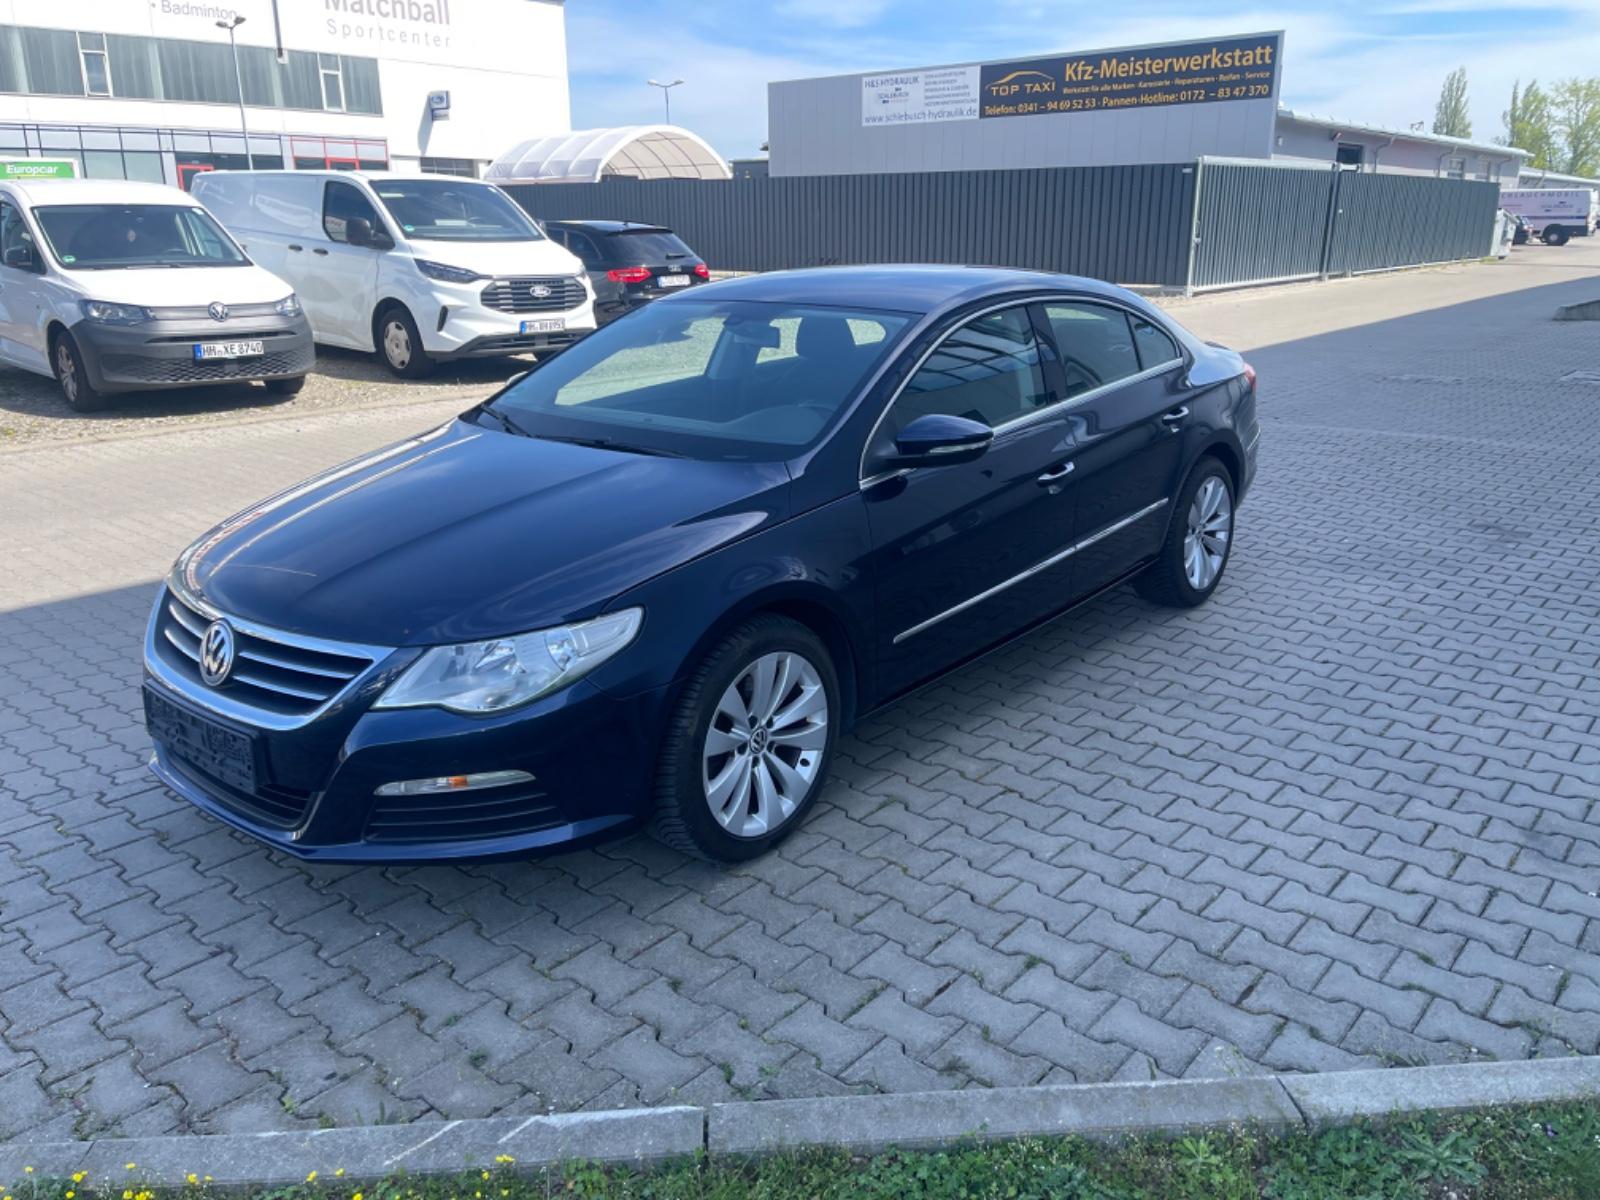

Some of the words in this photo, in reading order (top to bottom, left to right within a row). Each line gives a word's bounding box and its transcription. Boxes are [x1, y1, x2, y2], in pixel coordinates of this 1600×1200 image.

[161, 0, 238, 19] Badminton
[326, 18, 450, 48] Sportcenter
[1065, 45, 1273, 82] Kfz-Meisterwerkstatt
[991, 85, 1020, 96] TOP
[1024, 81, 1055, 94] TAXI
[985, 104, 1016, 115] Telefon:
[1047, 102, 1057, 111] 94
[1180, 90, 1205, 101] 0172
[1217, 88, 1230, 98] 83
[1232, 86, 1246, 96] 47
[1249, 84, 1269, 95] 370
[6, 164, 58, 176] Europcar
[1501, 191, 1579, 199] CHLAUCHMOBIL
